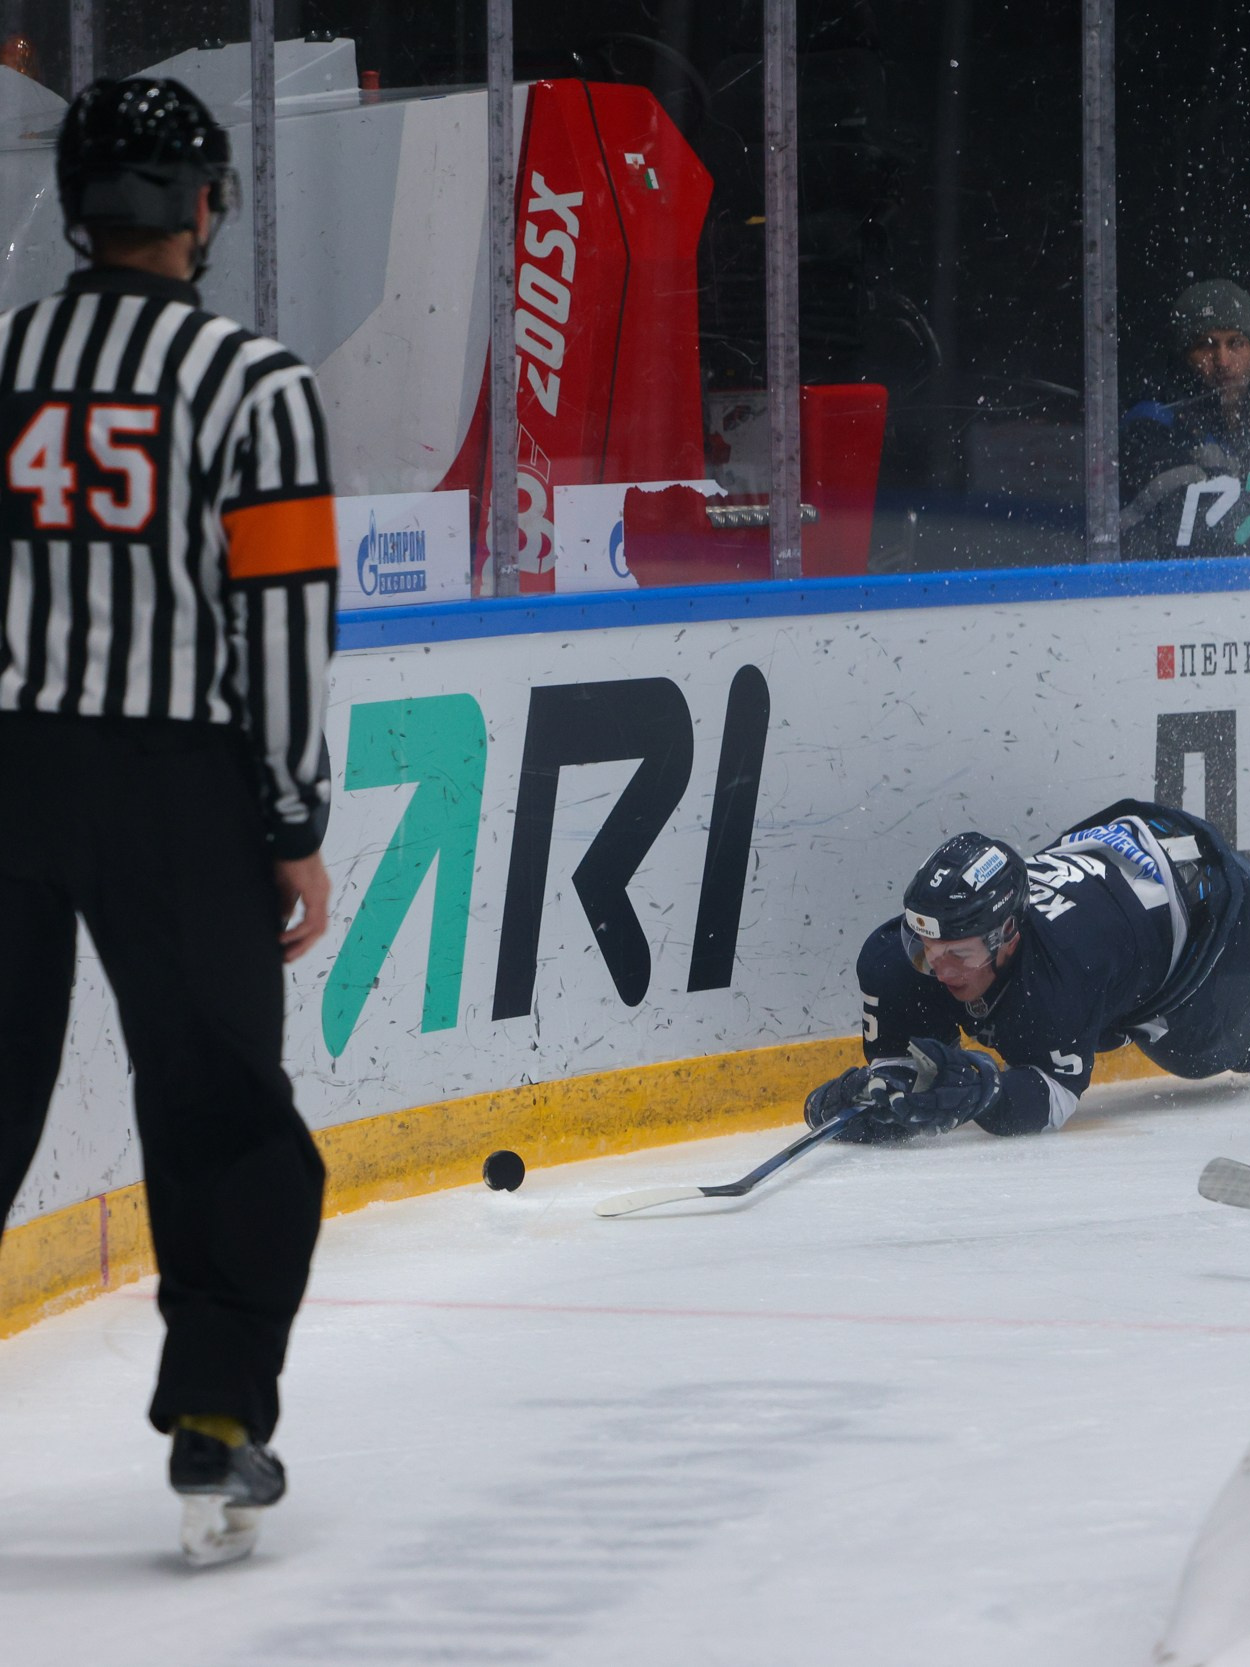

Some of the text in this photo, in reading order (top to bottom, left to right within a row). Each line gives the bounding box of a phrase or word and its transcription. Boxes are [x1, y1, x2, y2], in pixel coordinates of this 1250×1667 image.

[7, 401, 160, 533] 45
[378, 530, 426, 564] ГАЗПРОМ
[380, 573, 425, 592] ЭКСПОРТ
[930, 868, 951, 888] 5
[862, 995, 880, 1043] 5
